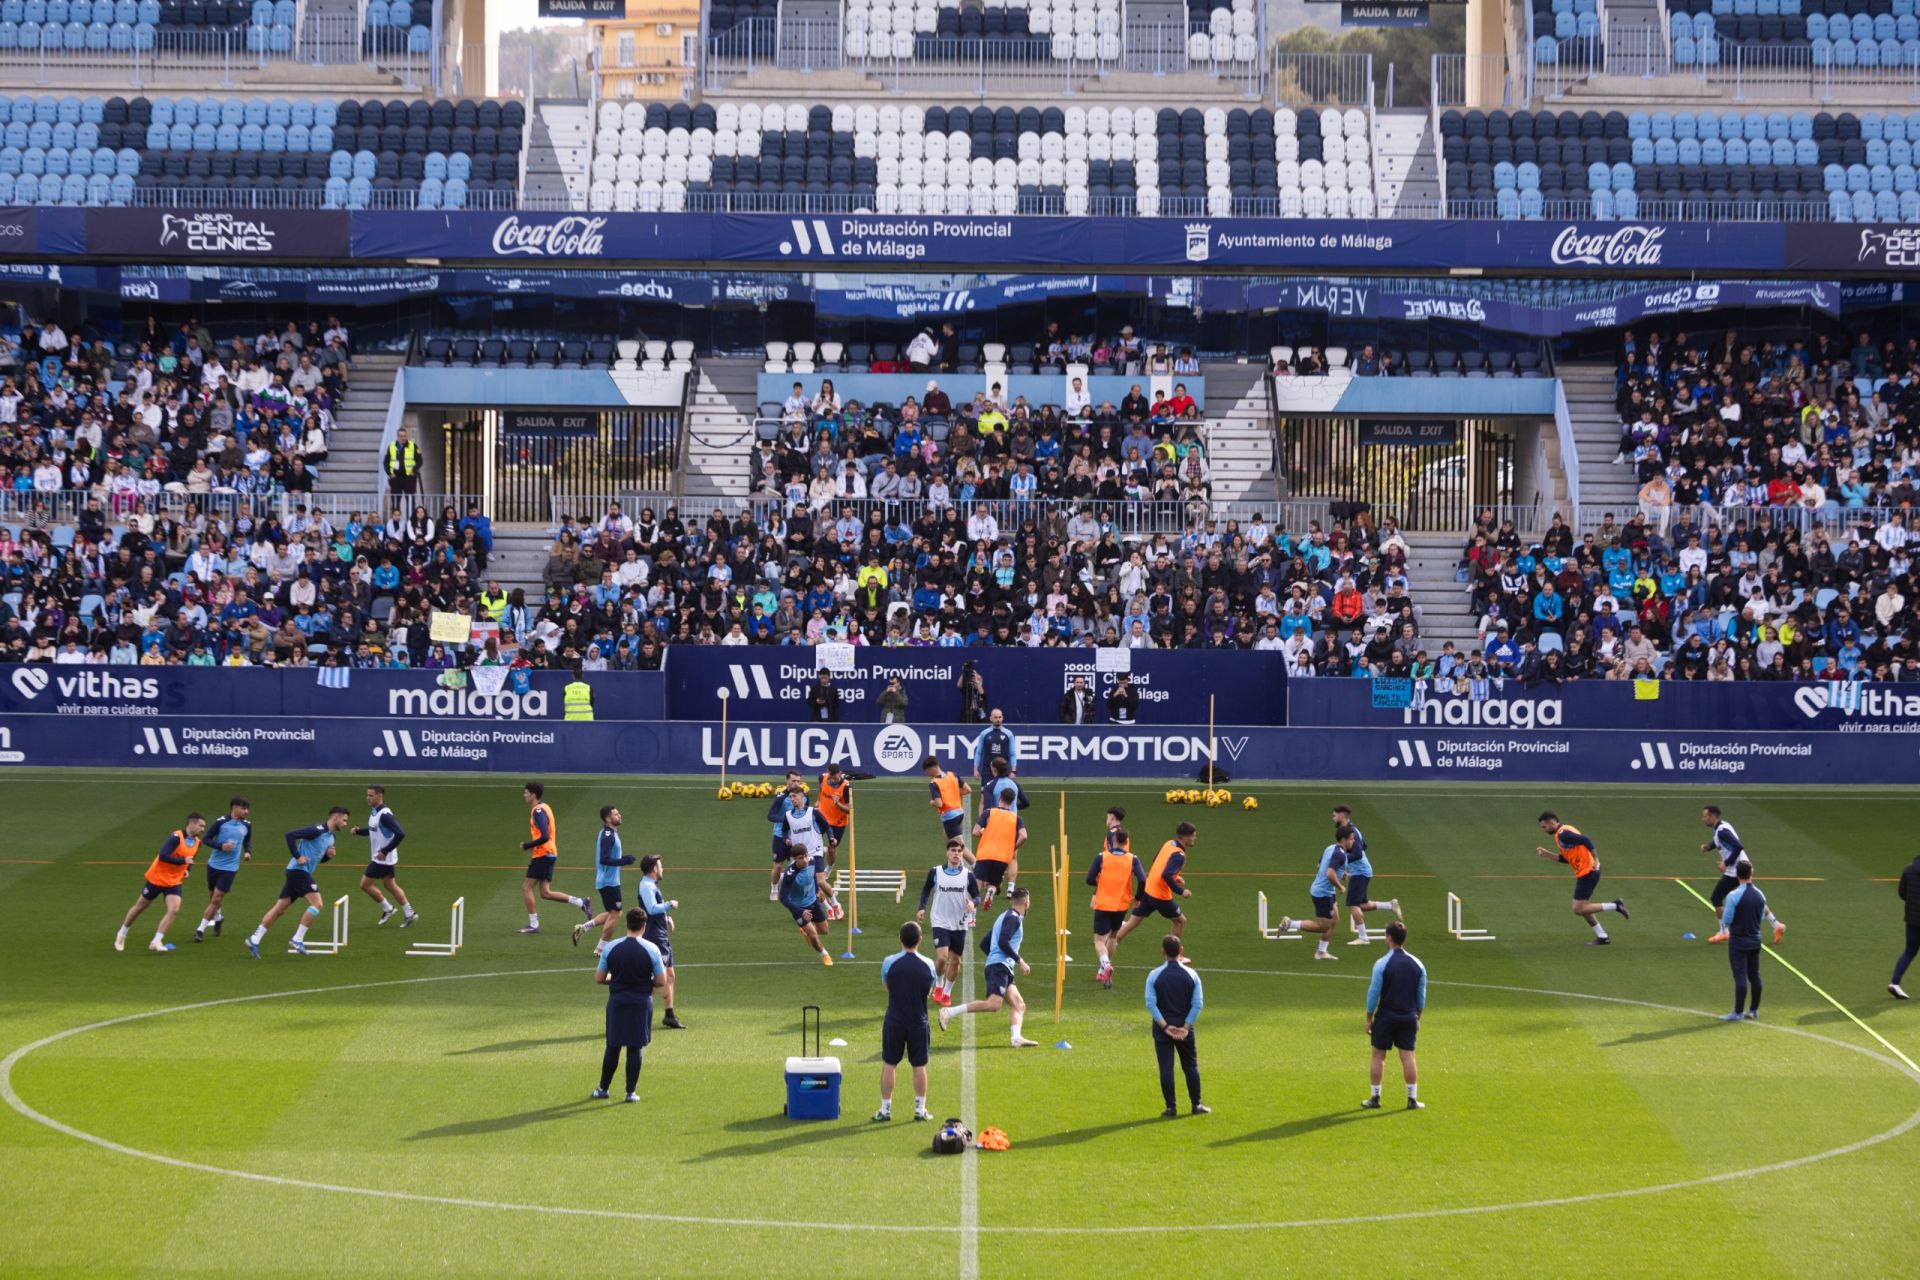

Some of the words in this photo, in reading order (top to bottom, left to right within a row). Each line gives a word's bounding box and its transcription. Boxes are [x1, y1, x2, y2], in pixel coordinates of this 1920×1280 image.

[1353, 7, 1390, 17] SALIDA
[1397, 7, 1419, 17] EXIT
[194, 213, 233, 222] GRUPO
[187, 221, 276, 236] DENTAL
[492, 215, 608, 256] Coca-Cola
[842, 220, 929, 239] Diputación
[933, 221, 1012, 238] Provincial
[187, 235, 272, 251] CLINICS
[1217, 232, 1316, 250] Ayuntamiento
[1319, 233, 1337, 248] de
[1341, 233, 1393, 251] Málaga
[1550, 225, 1667, 265] Coca-Cola
[841, 241, 862, 256] de
[866, 240, 926, 259] Málaga
[516, 416, 556, 428] SALIDA
[562, 416, 588, 428] EXIT
[1373, 424, 1413, 436] SALIDA
[1419, 425, 1444, 436] EXIT
[873, 664, 952, 680] Provincial
[56, 671, 160, 699] vithas
[779, 684, 801, 699] de
[56, 703, 82, 714] vivir
[84, 704, 109, 716] para
[111, 704, 159, 716] cuidarte
[182, 727, 251, 741] Diputación
[253, 728, 315, 741] Provincial
[1838, 722, 1863, 733] vivir
[1865, 724, 1891, 733] para
[421, 730, 490, 745] Diputación
[492, 731, 554, 744] Provincial
[883, 735, 913, 750] EA
[182, 744, 199, 755] de
[202, 743, 249, 757] Málaga
[421, 746, 438, 757] de
[441, 745, 488, 759] Málaga
[702, 727, 862, 767] LALIGA
[928, 734, 1218, 761] HYERMOTION
[1437, 739, 1505, 754] Diputación
[1508, 740, 1570, 753] Provincial
[1679, 742, 1748, 756] Diputación
[1750, 743, 1812, 756] Provincial
[881, 751, 914, 759] SPORTS
[1437, 756, 1453, 767] de
[1456, 755, 1503, 770] Málaga
[1679, 758, 1695, 770] de
[1698, 758, 1745, 772] Málaga
